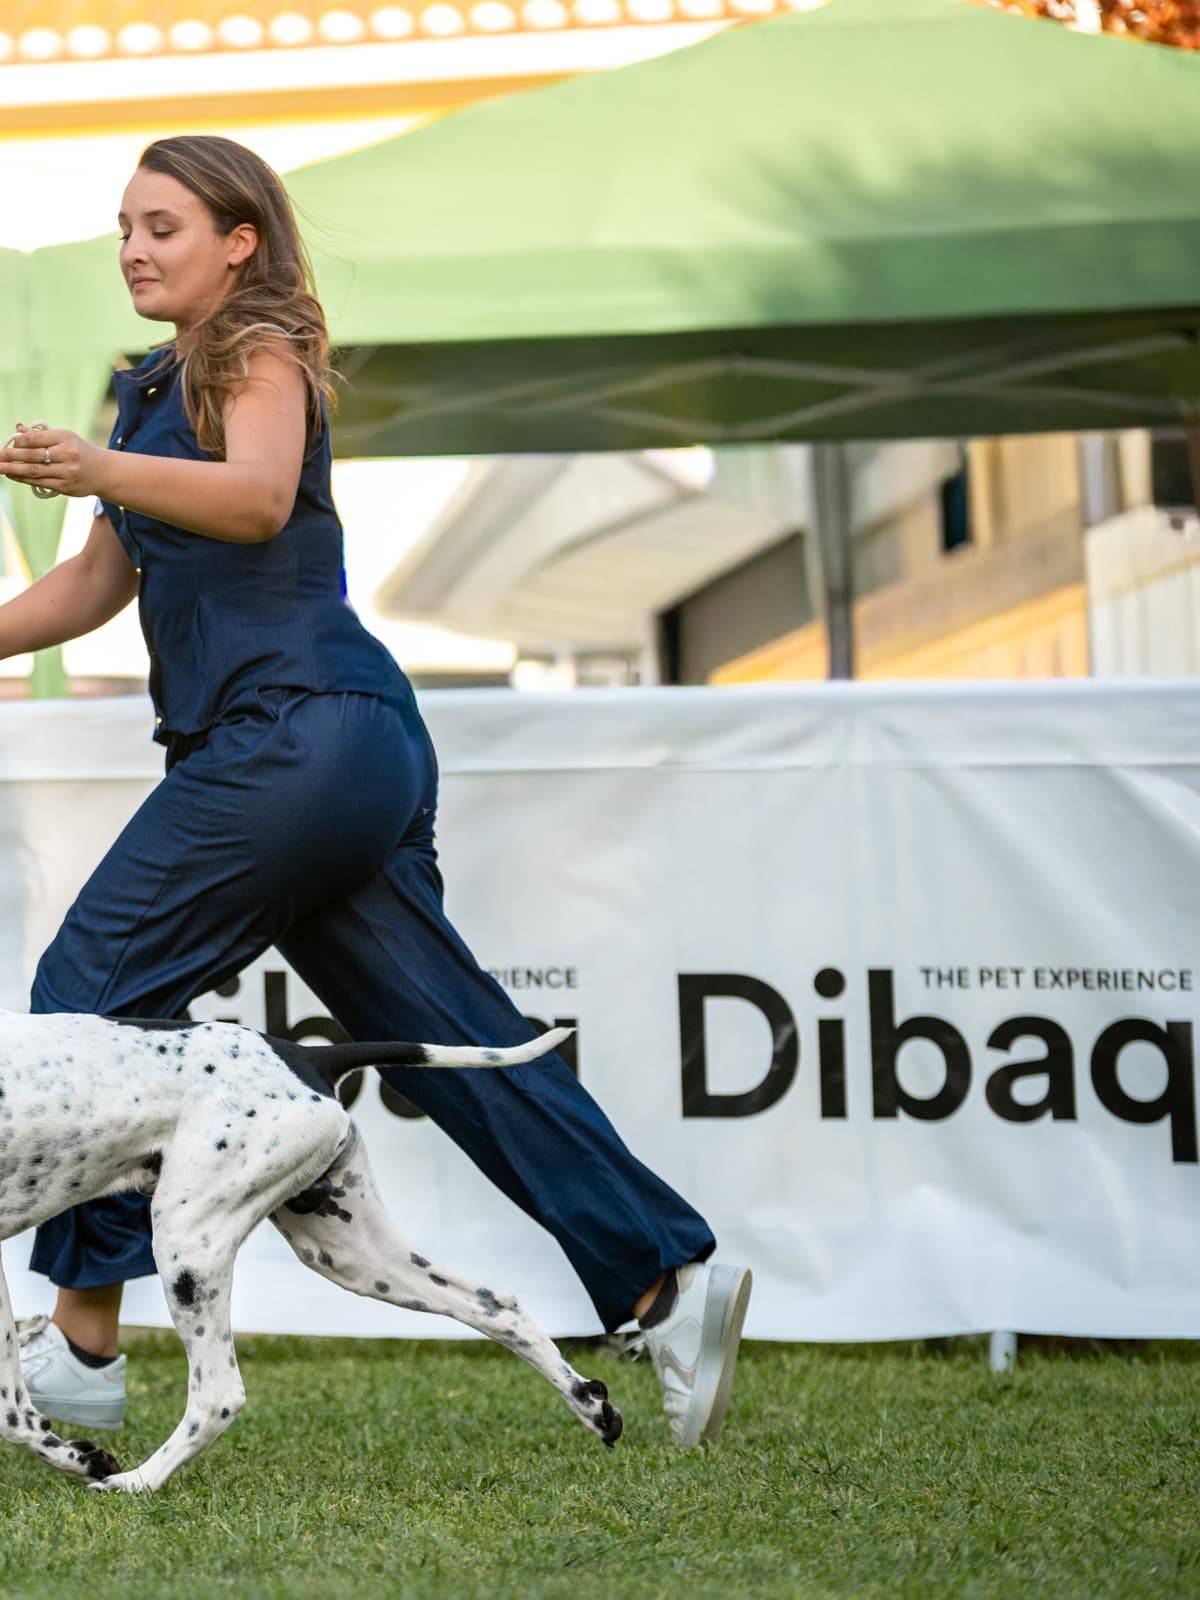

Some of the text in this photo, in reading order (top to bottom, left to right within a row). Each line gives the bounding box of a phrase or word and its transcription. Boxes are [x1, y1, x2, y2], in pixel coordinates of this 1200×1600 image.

[919, 966, 1193, 991] THE PET EXPERIENCE
[677, 966, 1199, 1164] Dibaq
